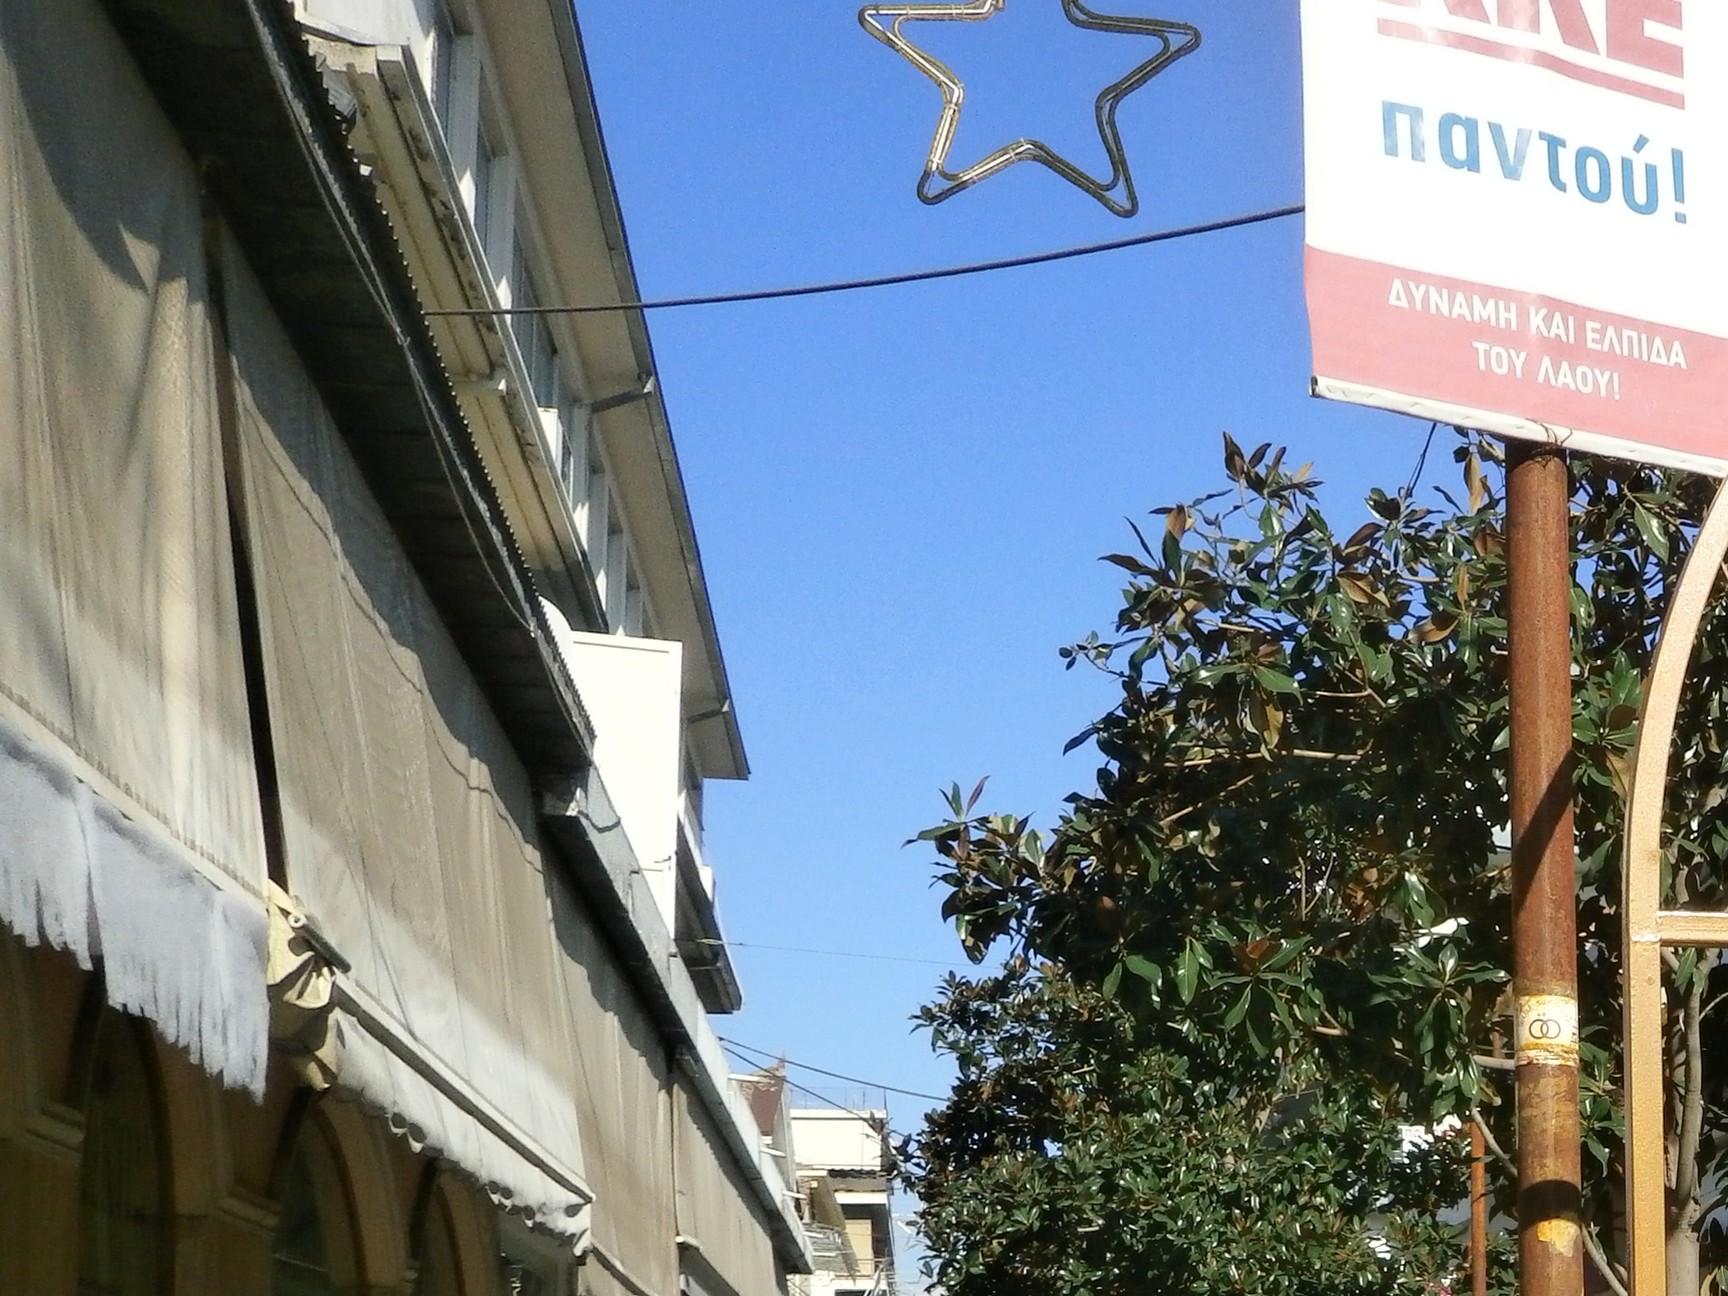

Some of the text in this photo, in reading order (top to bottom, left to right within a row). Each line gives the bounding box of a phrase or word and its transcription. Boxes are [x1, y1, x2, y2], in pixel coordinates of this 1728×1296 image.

[1381, 100, 1687, 224] παντού!
[1387, 278, 1688, 370] ΔΥΝΑΜΗ ΚΑΙ ΕΛΠΙΔΑ
[1472, 341, 1620, 400] ΤΟΥ ΛΑΟΥ!
